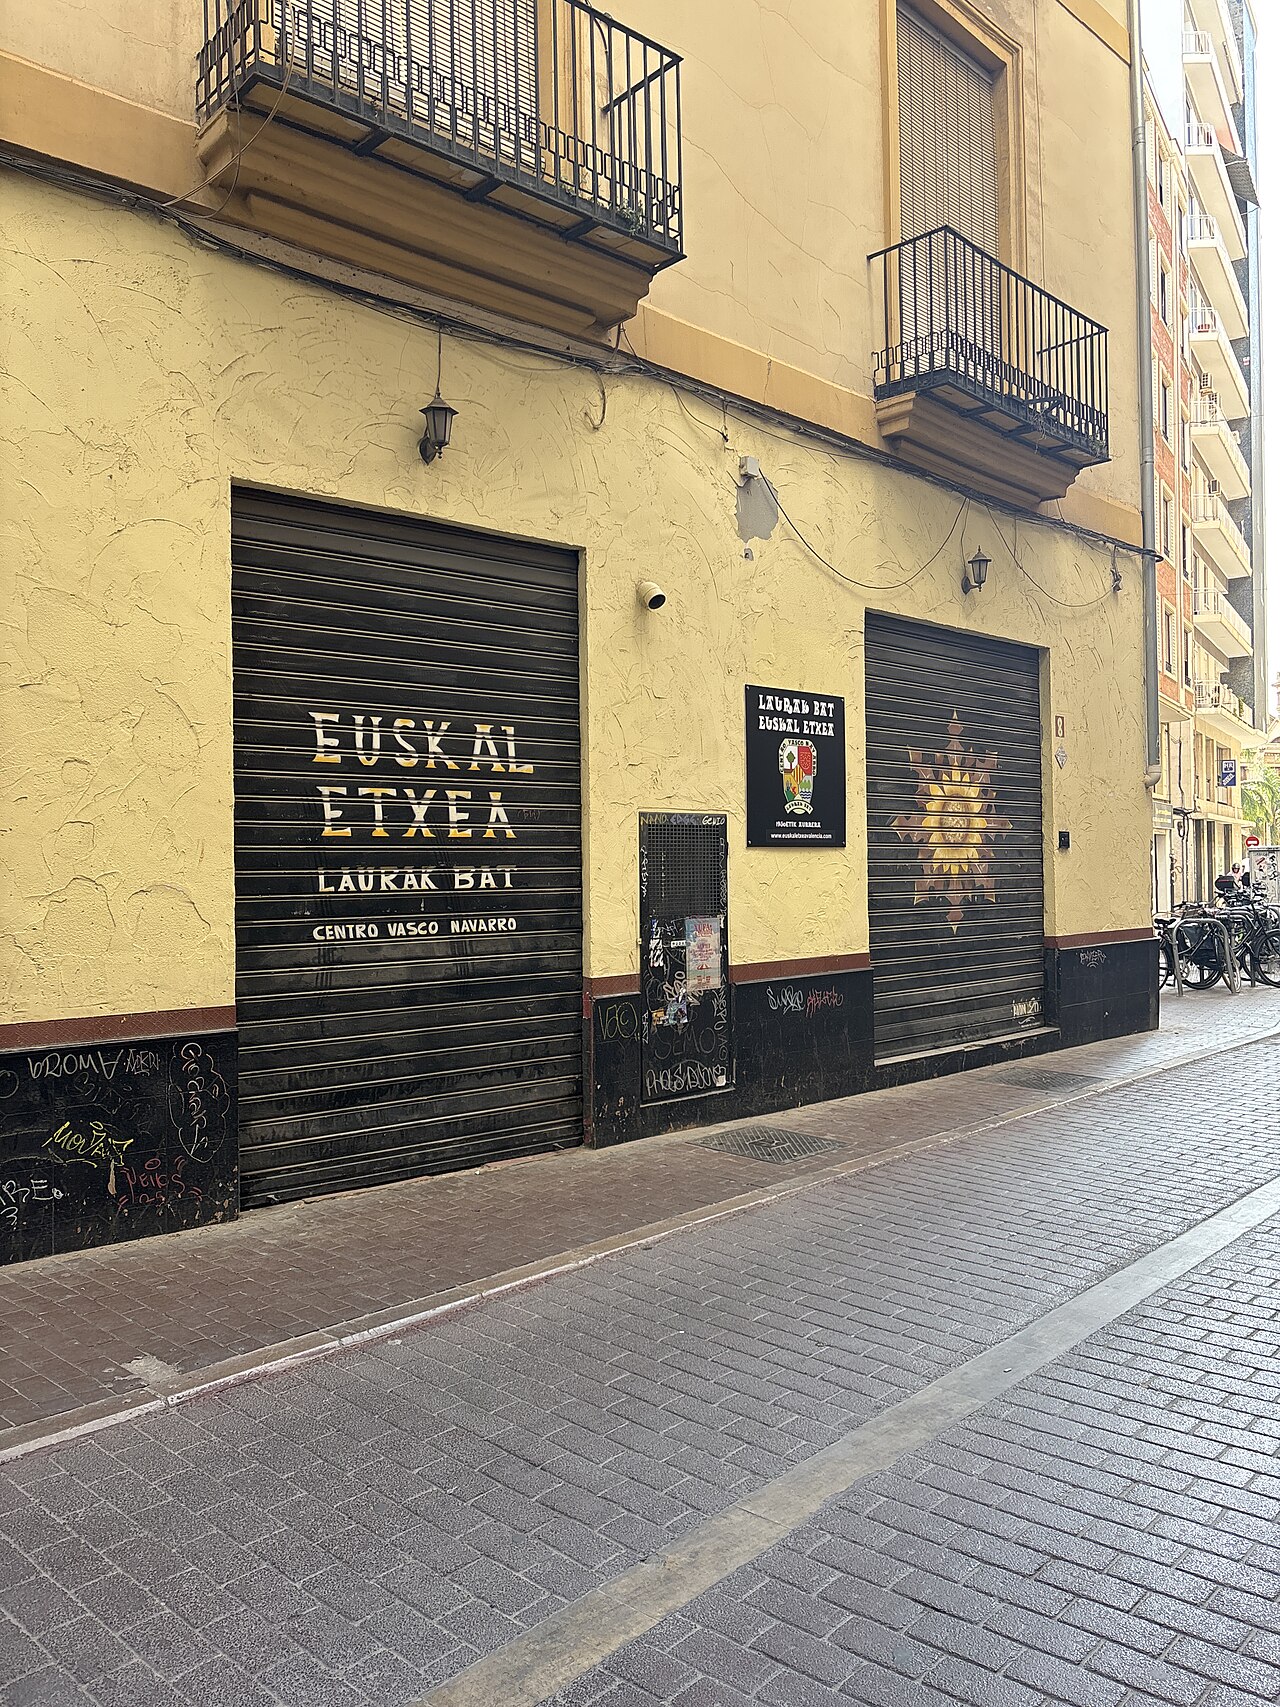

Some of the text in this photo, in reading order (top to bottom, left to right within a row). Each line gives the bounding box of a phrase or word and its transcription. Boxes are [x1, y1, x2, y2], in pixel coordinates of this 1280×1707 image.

[758, 694, 835, 718] LAURAK BAT
[758, 715, 835, 737] EUSKAL ETXEA
[1057, 716, 1063, 737] 8
[308, 711, 534, 774] EUSKAL
[315, 786, 518, 839] ETXEA
[317, 864, 518, 893] LAURAK BAT
[312, 917, 518, 941] CENTRO VASCO NAVARRO
